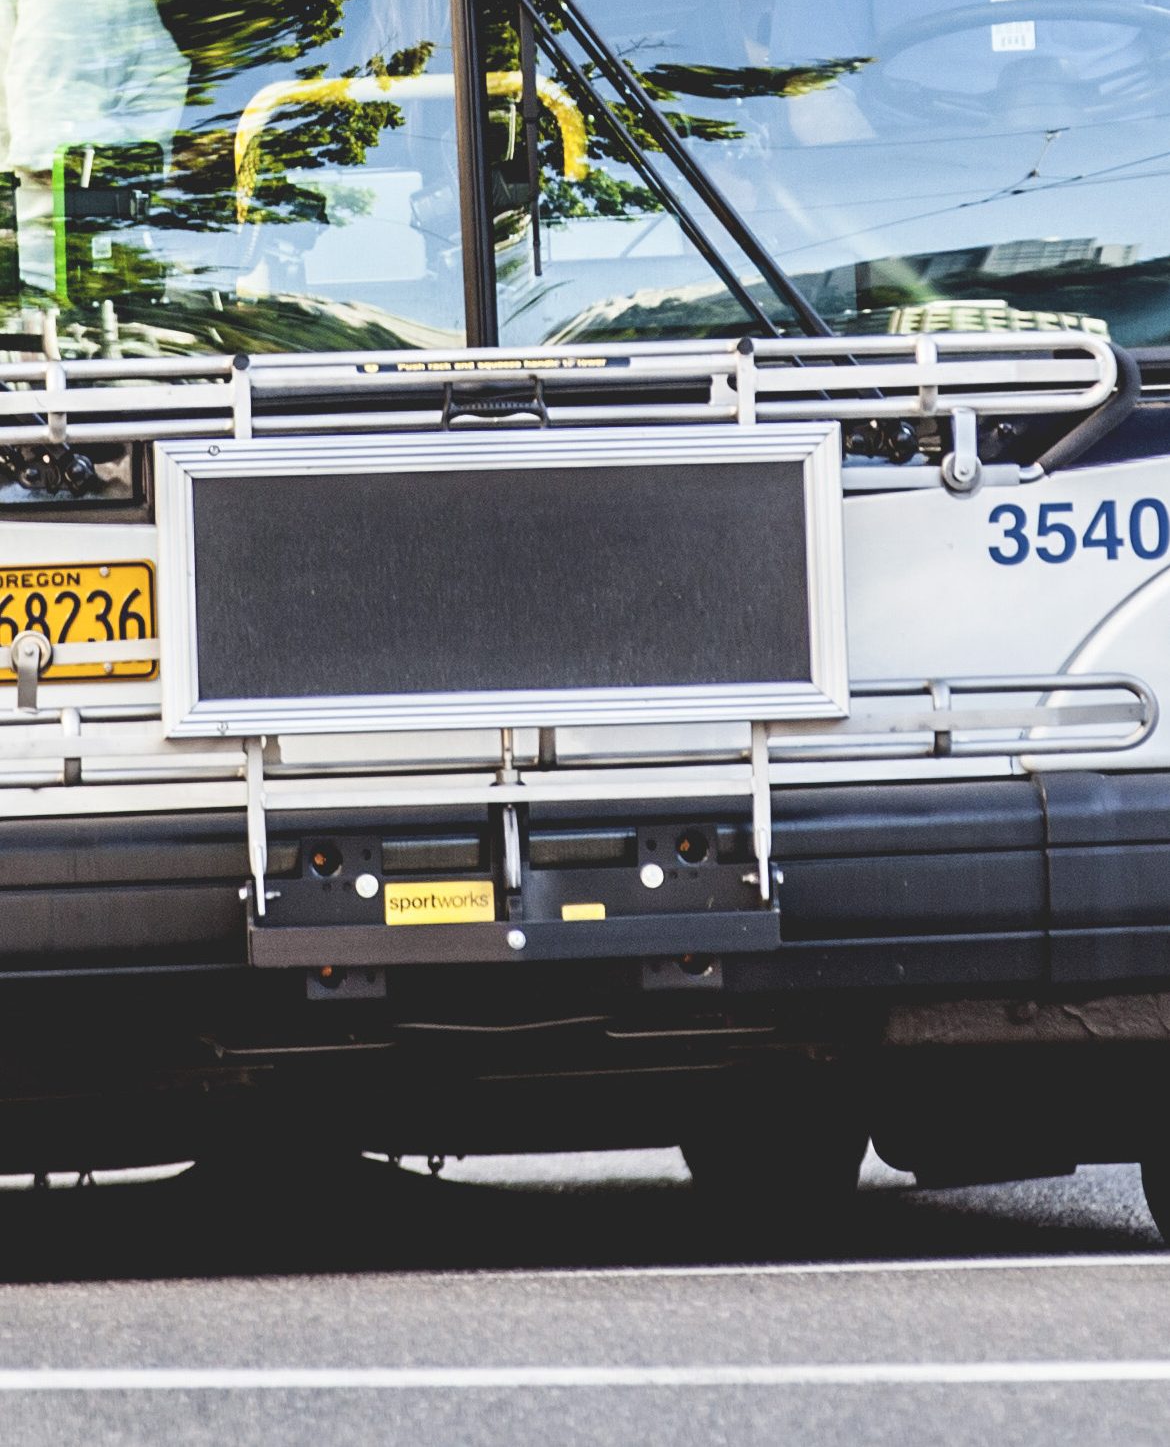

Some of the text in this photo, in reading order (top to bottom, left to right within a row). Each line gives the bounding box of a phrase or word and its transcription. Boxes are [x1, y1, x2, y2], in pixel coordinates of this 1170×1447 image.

[397, 361, 426, 372] Push
[453, 360, 475, 371] and
[523, 358, 560, 369] handle
[988, 497, 1170, 566] 3540
[0, 572, 81, 588] REGON
[390, 891, 489, 912] sportworks
